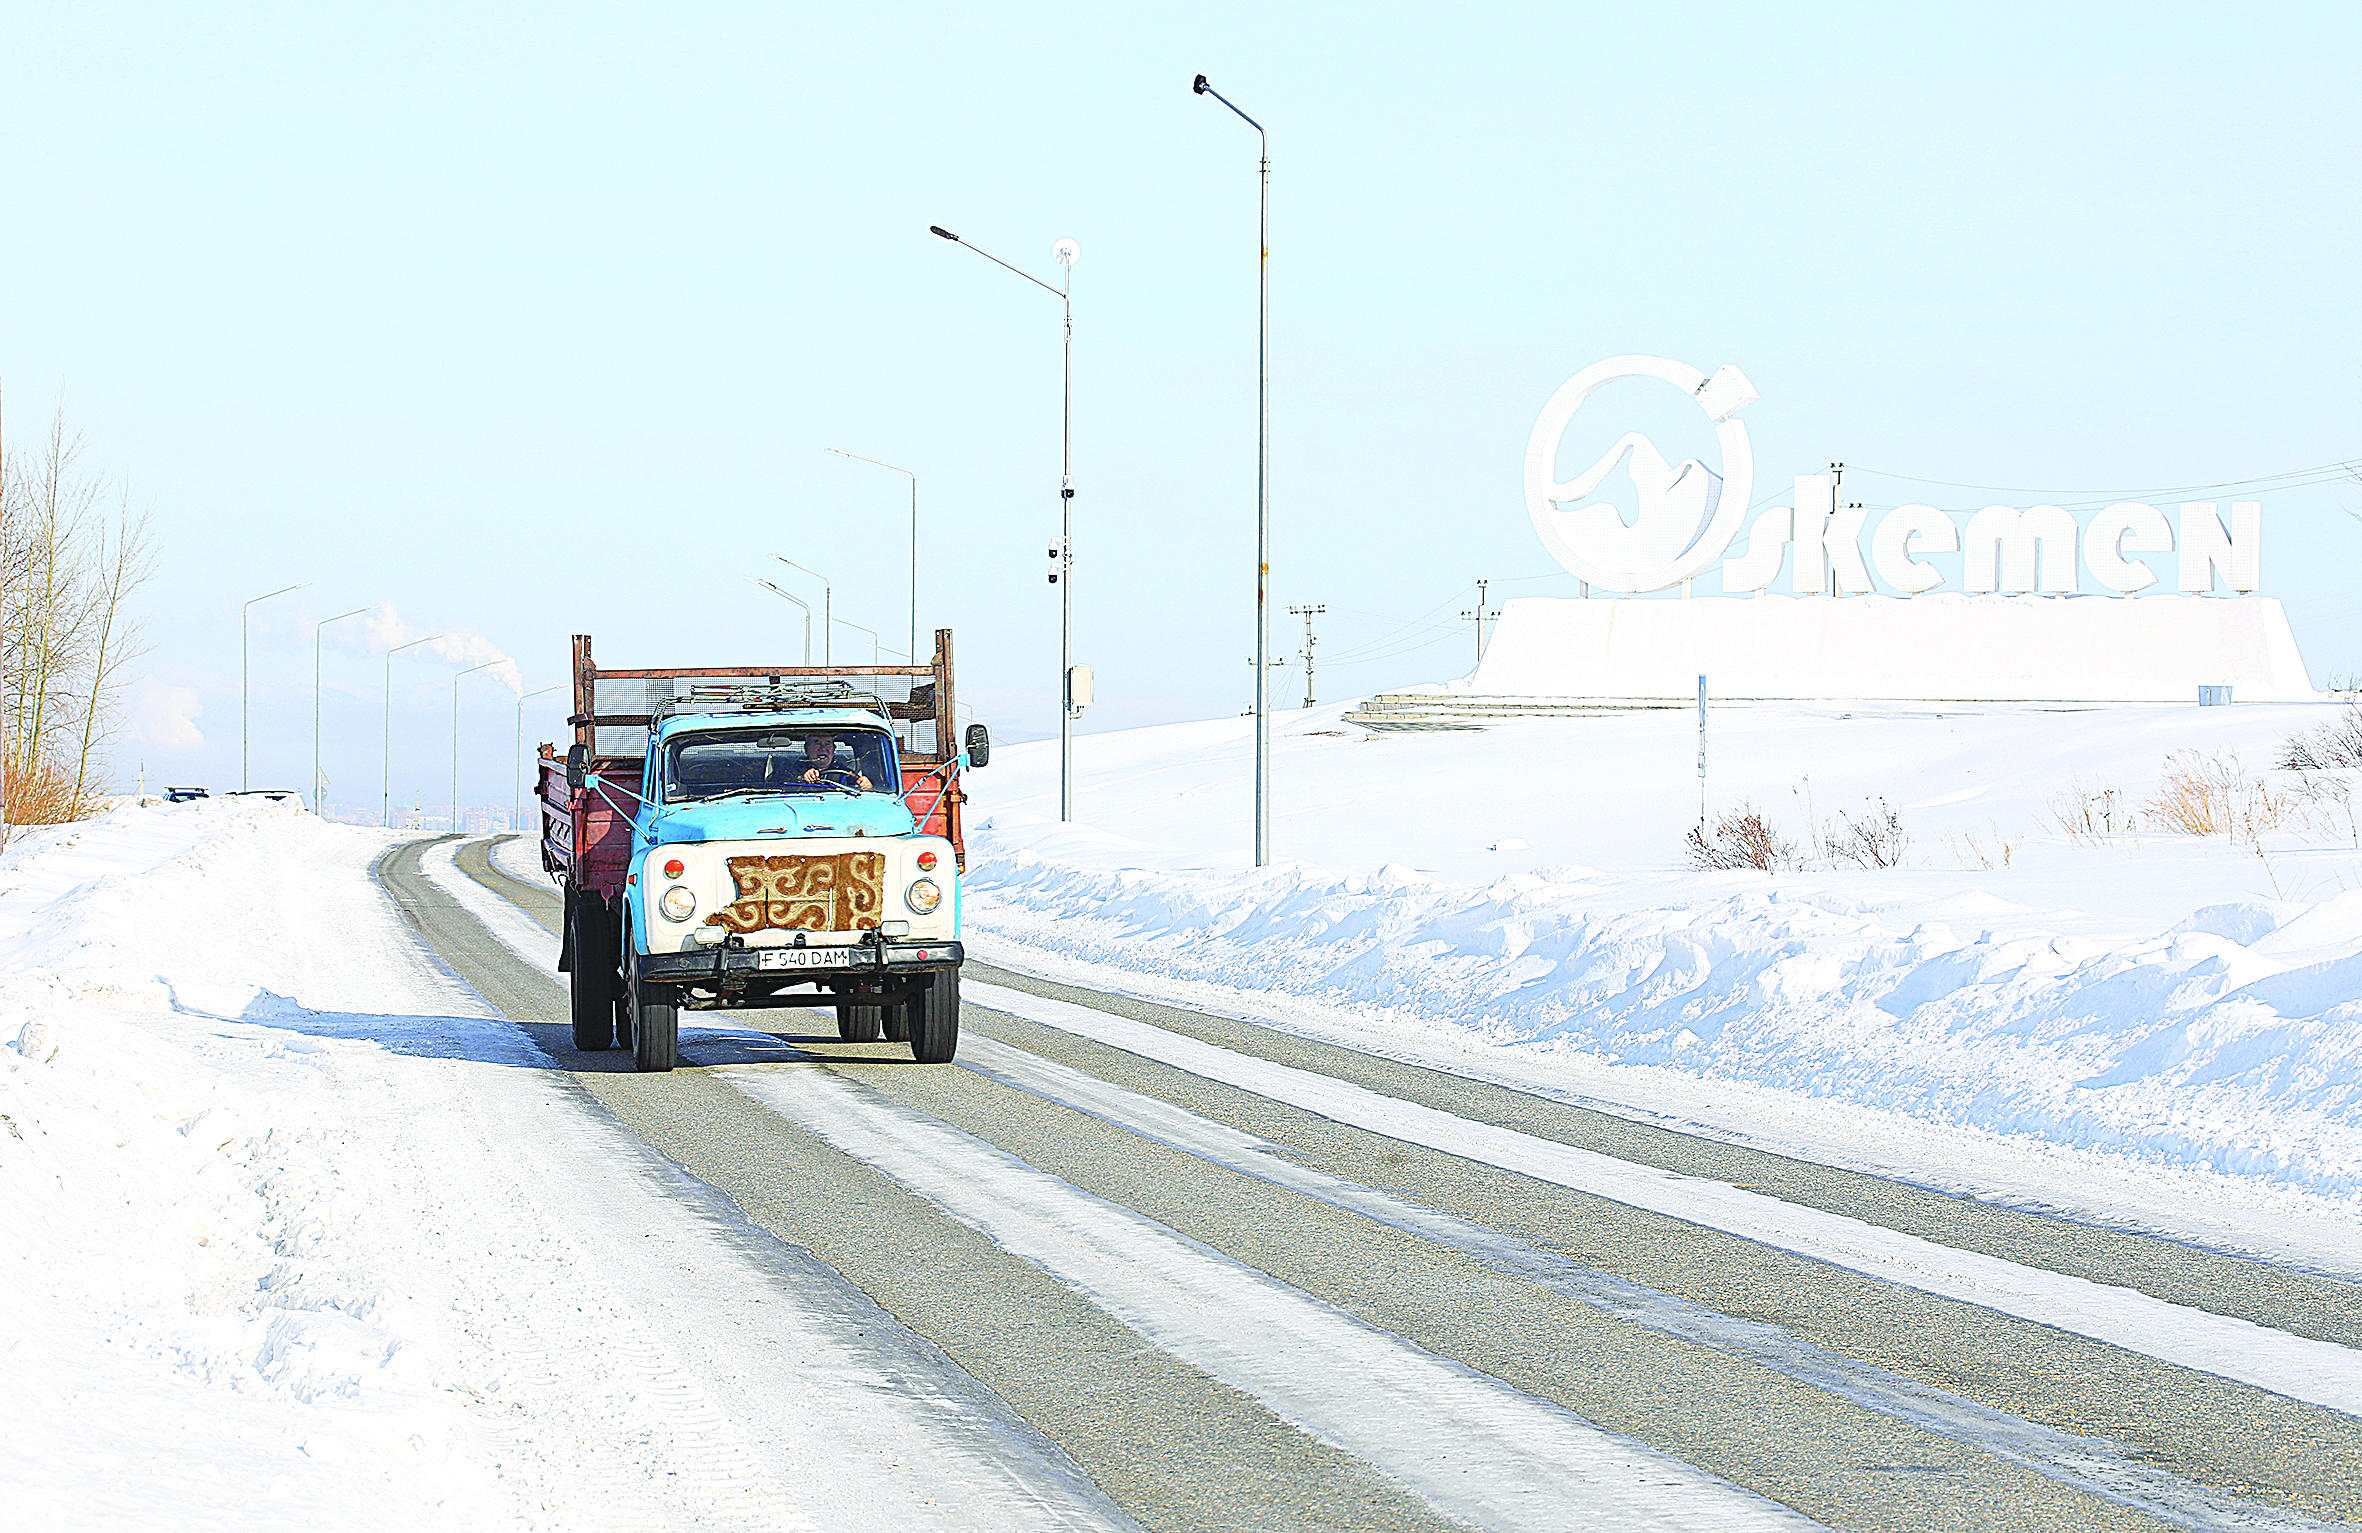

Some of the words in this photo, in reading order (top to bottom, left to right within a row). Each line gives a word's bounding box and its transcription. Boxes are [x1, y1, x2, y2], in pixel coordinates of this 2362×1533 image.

[764, 952, 774, 967] F
[778, 951, 806, 967] 540
[811, 950, 846, 965] DAM
